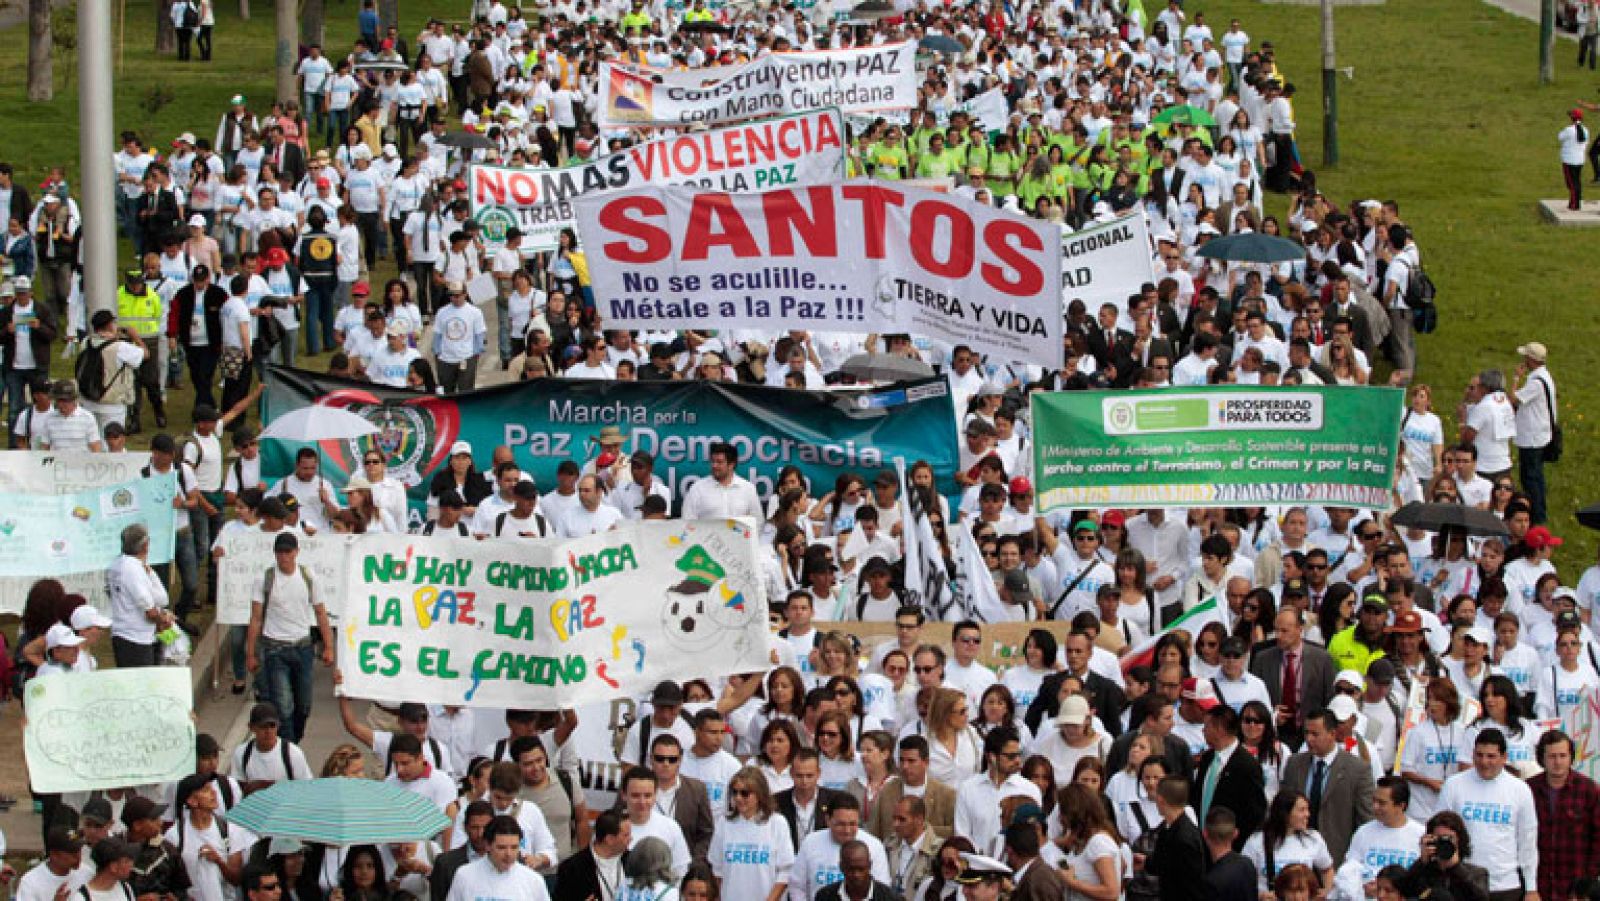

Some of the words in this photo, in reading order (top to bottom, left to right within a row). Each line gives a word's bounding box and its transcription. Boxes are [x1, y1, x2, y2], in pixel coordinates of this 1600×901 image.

[667, 56, 846, 101] Construyendo
[855, 50, 901, 74] PAZ
[680, 109, 719, 123] con
[726, 93, 784, 118] Mano
[791, 83, 895, 109] Ciudadana
[475, 168, 539, 206] NO
[541, 155, 630, 204] MAS
[630, 113, 841, 182] VIOLENCIA
[721, 172, 749, 192] LA
[755, 163, 797, 188] PAZ
[518, 202, 578, 224] TRAB
[598, 184, 1045, 297] SANTOS
[623, 272, 659, 293] No
[669, 275, 701, 292] se
[711, 267, 848, 291] aculille...
[610, 298, 709, 320] Métale
[719, 303, 736, 318] a
[745, 297, 771, 319] la
[780, 296, 826, 319] Paz
[893, 278, 965, 320] TIERRA
[970, 301, 984, 322] Y
[991, 306, 1049, 338] VIDA
[550, 400, 646, 423] Marcha
[653, 411, 682, 425] por
[683, 409, 697, 422] la
[1227, 399, 1312, 410] PROSPERIDAD
[1227, 410, 1261, 422] PARA
[1266, 410, 1312, 422] TODOS
[504, 424, 571, 456] Paz
[584, 440, 596, 457] y
[1106, 444, 1120, 456] de
[1125, 443, 1174, 456] Ambiente
[1248, 438, 1305, 453] Sostenible
[1310, 442, 1359, 454] presente
[1362, 444, 1376, 455] en
[1378, 443, 1389, 456] la
[1088, 460, 1132, 474] contra
[1135, 459, 1150, 473] el
[1231, 457, 1244, 471] el
[1250, 457, 1299, 471] Crimen
[1303, 459, 1313, 473] y
[1316, 460, 1344, 473] por
[1347, 456, 1360, 471] la
[1363, 458, 1387, 474] Paz
[363, 554, 407, 584] NO
[415, 556, 473, 587] HAY
[486, 560, 569, 592] CAMINO
[368, 594, 403, 627] LA
[494, 602, 534, 641] LA
[549, 594, 605, 642] PAZ
[358, 640, 401, 677] ES
[416, 646, 460, 679] EL
[472, 649, 588, 688] CAMINO
[1462, 806, 1512, 825] CREER
[724, 850, 770, 865] CREER
